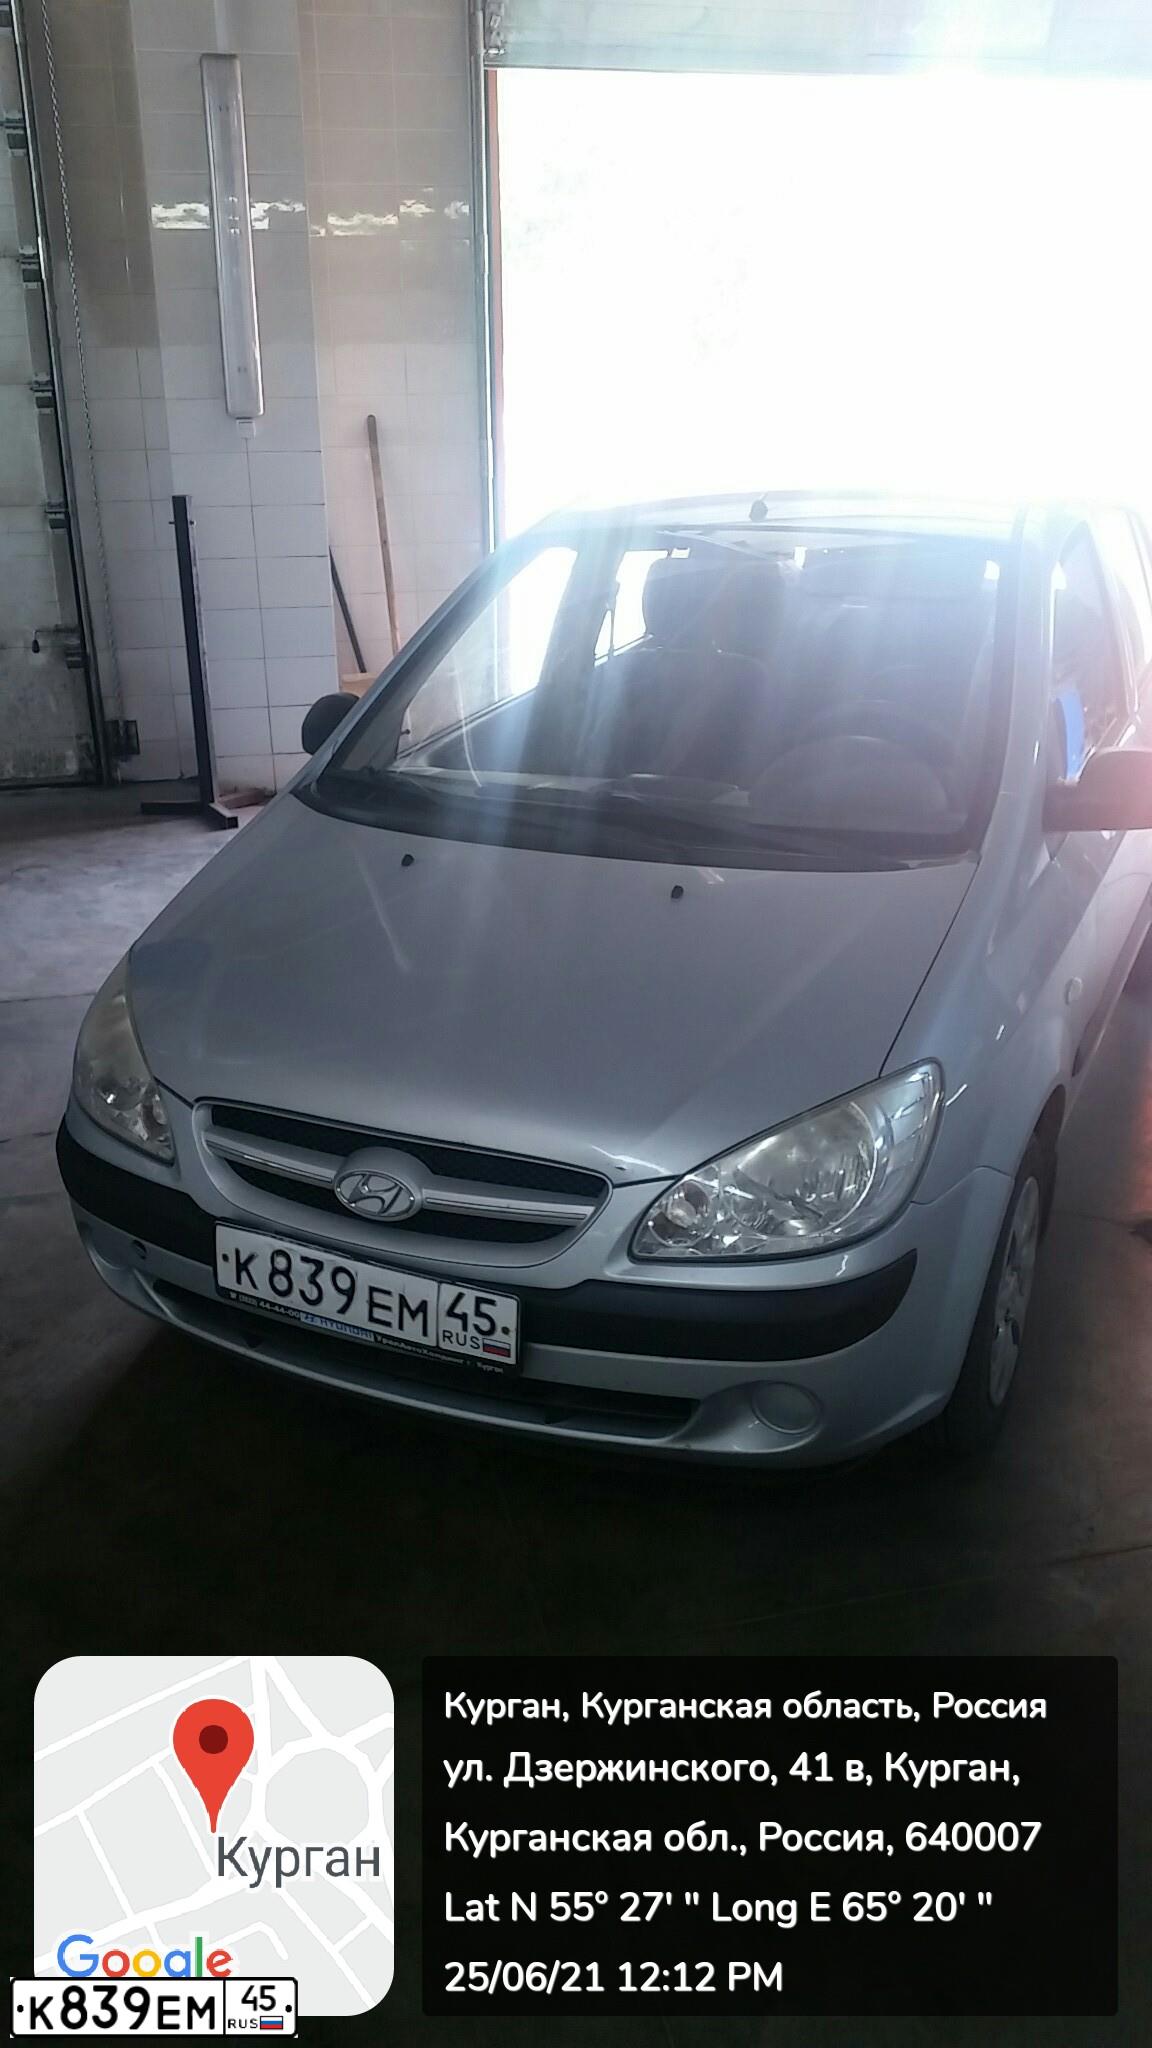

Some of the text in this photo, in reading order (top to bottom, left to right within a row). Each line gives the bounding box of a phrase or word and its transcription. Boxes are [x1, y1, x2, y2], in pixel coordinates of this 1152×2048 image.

[445, 1291, 497, 1337] 45
[320, 1316, 373, 1340] HYUNDAI
[442, 1328, 480, 1350] RUS
